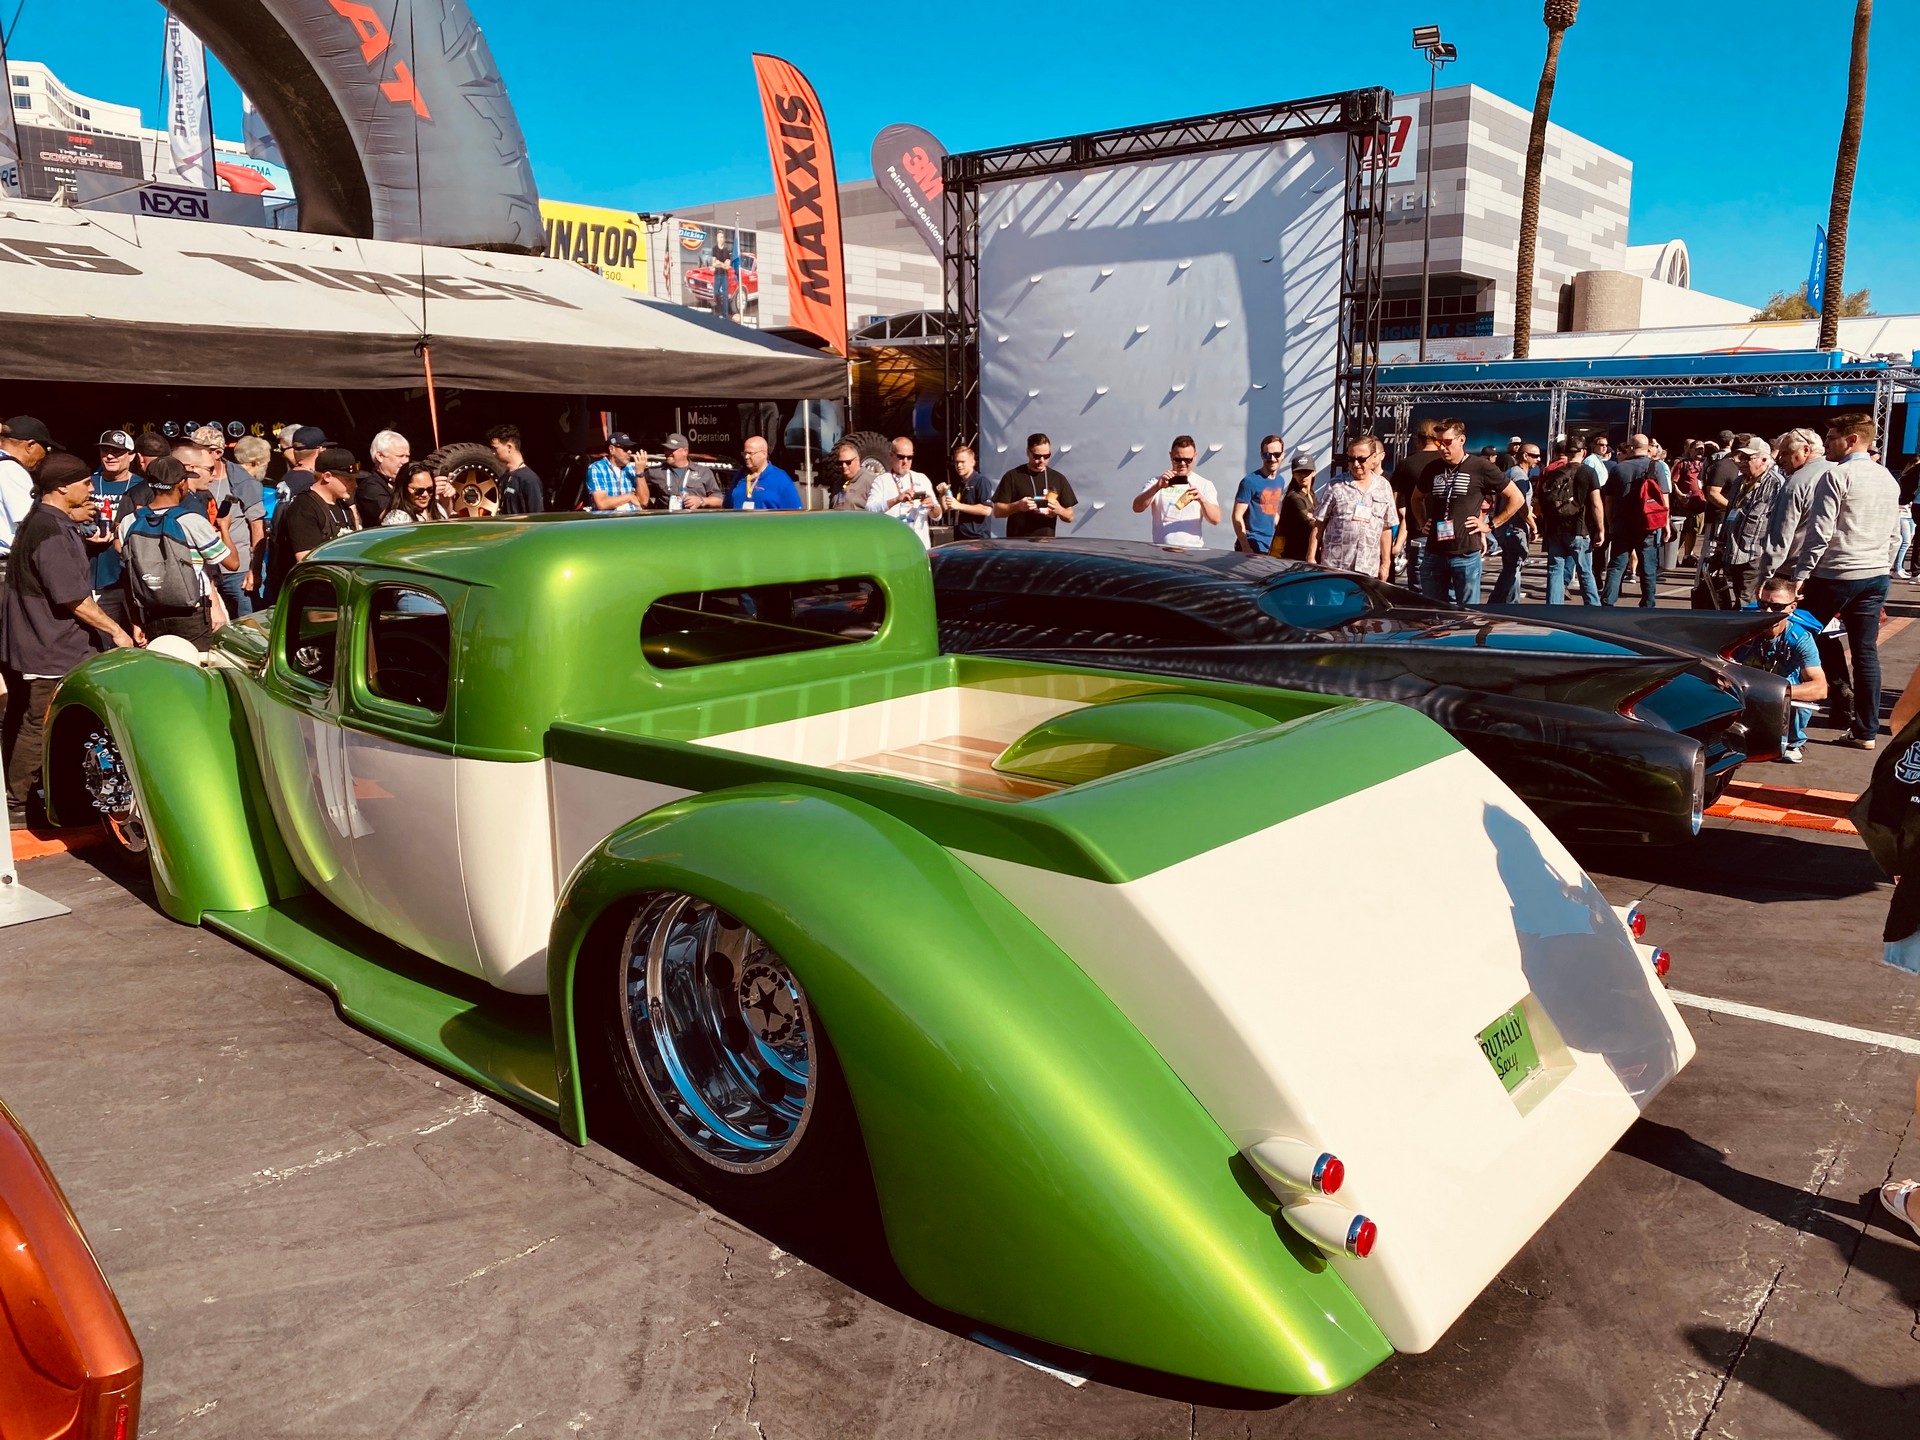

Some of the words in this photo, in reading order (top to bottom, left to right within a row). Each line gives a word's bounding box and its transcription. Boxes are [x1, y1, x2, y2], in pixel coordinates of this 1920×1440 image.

[40, 151, 123, 170] CORVETTES
[903, 146, 944, 201] 3M
[139, 191, 209, 218] NEXEN
[775, 93, 832, 307] MAXXIS
[886, 165, 905, 189] Paint
[902, 187, 919, 209] Prep
[916, 206, 944, 246] Solutions
[679, 229, 704, 240] Dickies
[177, 250, 583, 310] TIRES
[687, 411, 717, 425] Mobile
[688, 428, 730, 444] Operation
[1496, 1052, 1519, 1081] Sexy
